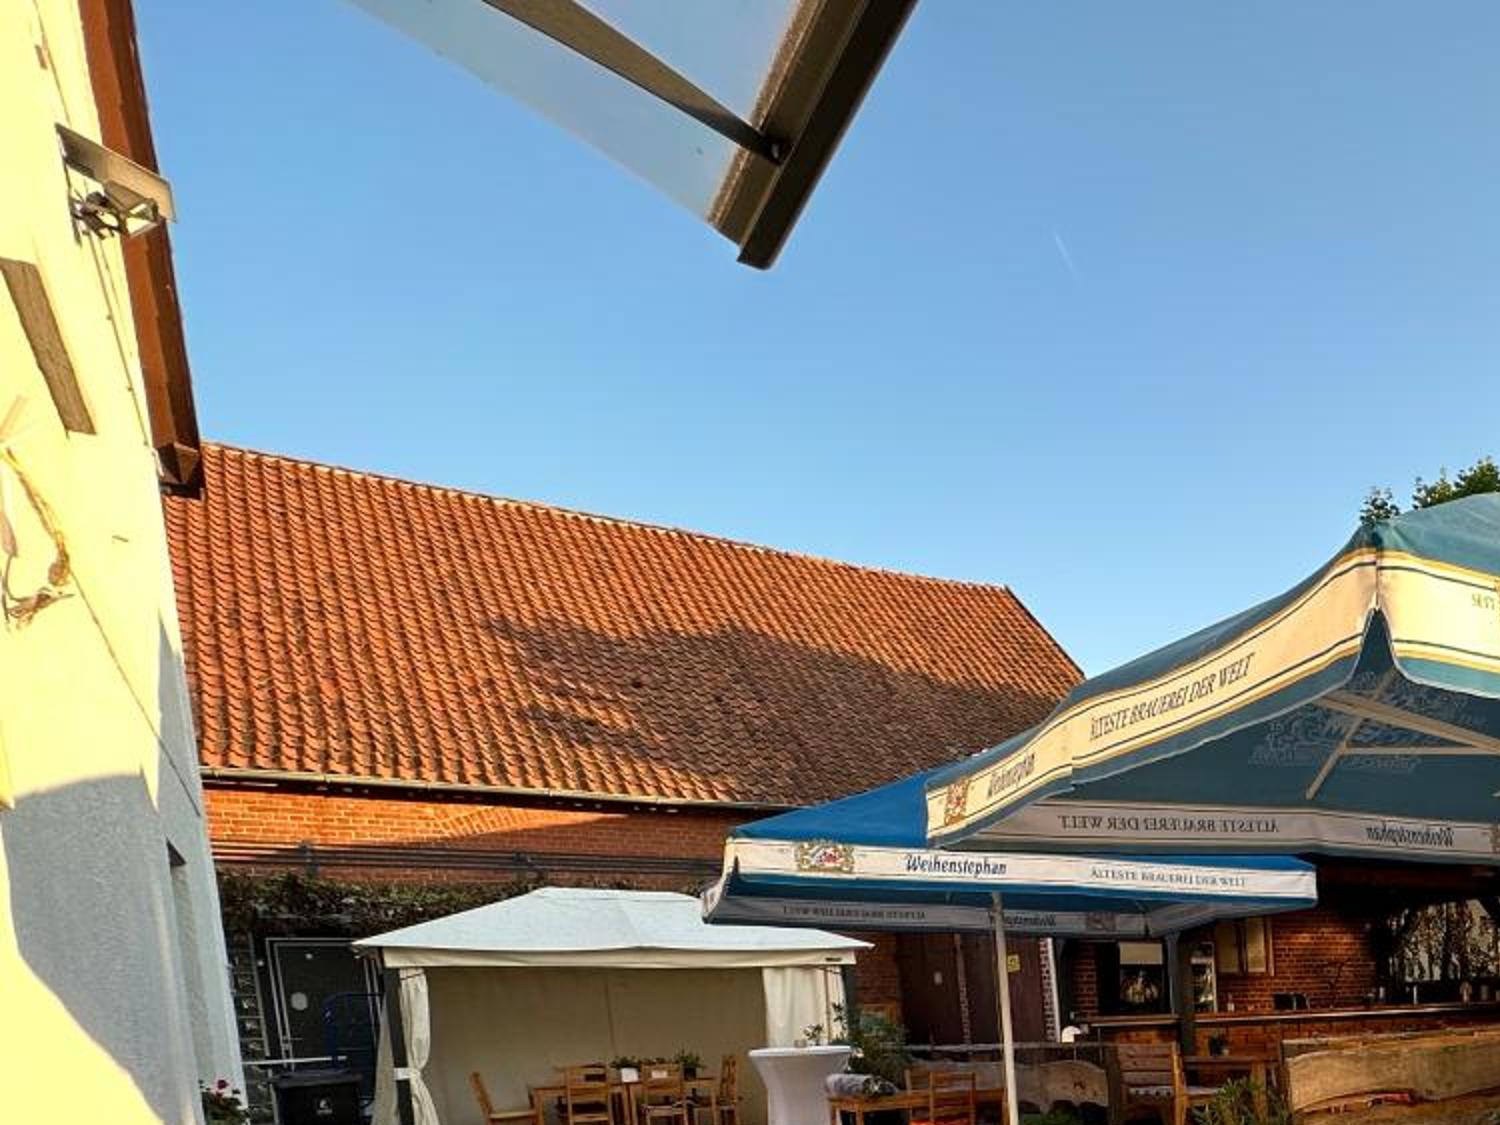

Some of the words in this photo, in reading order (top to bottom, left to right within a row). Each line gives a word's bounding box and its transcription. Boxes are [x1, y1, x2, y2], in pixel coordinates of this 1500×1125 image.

[1090, 707, 1131, 741] ÄLTESTE
[1130, 685, 1189, 725] BRAUEREI
[1189, 673, 1217, 703] DER
[1219, 652, 1256, 687] WELT
[905, 853, 1007, 879] Weihenstephan
